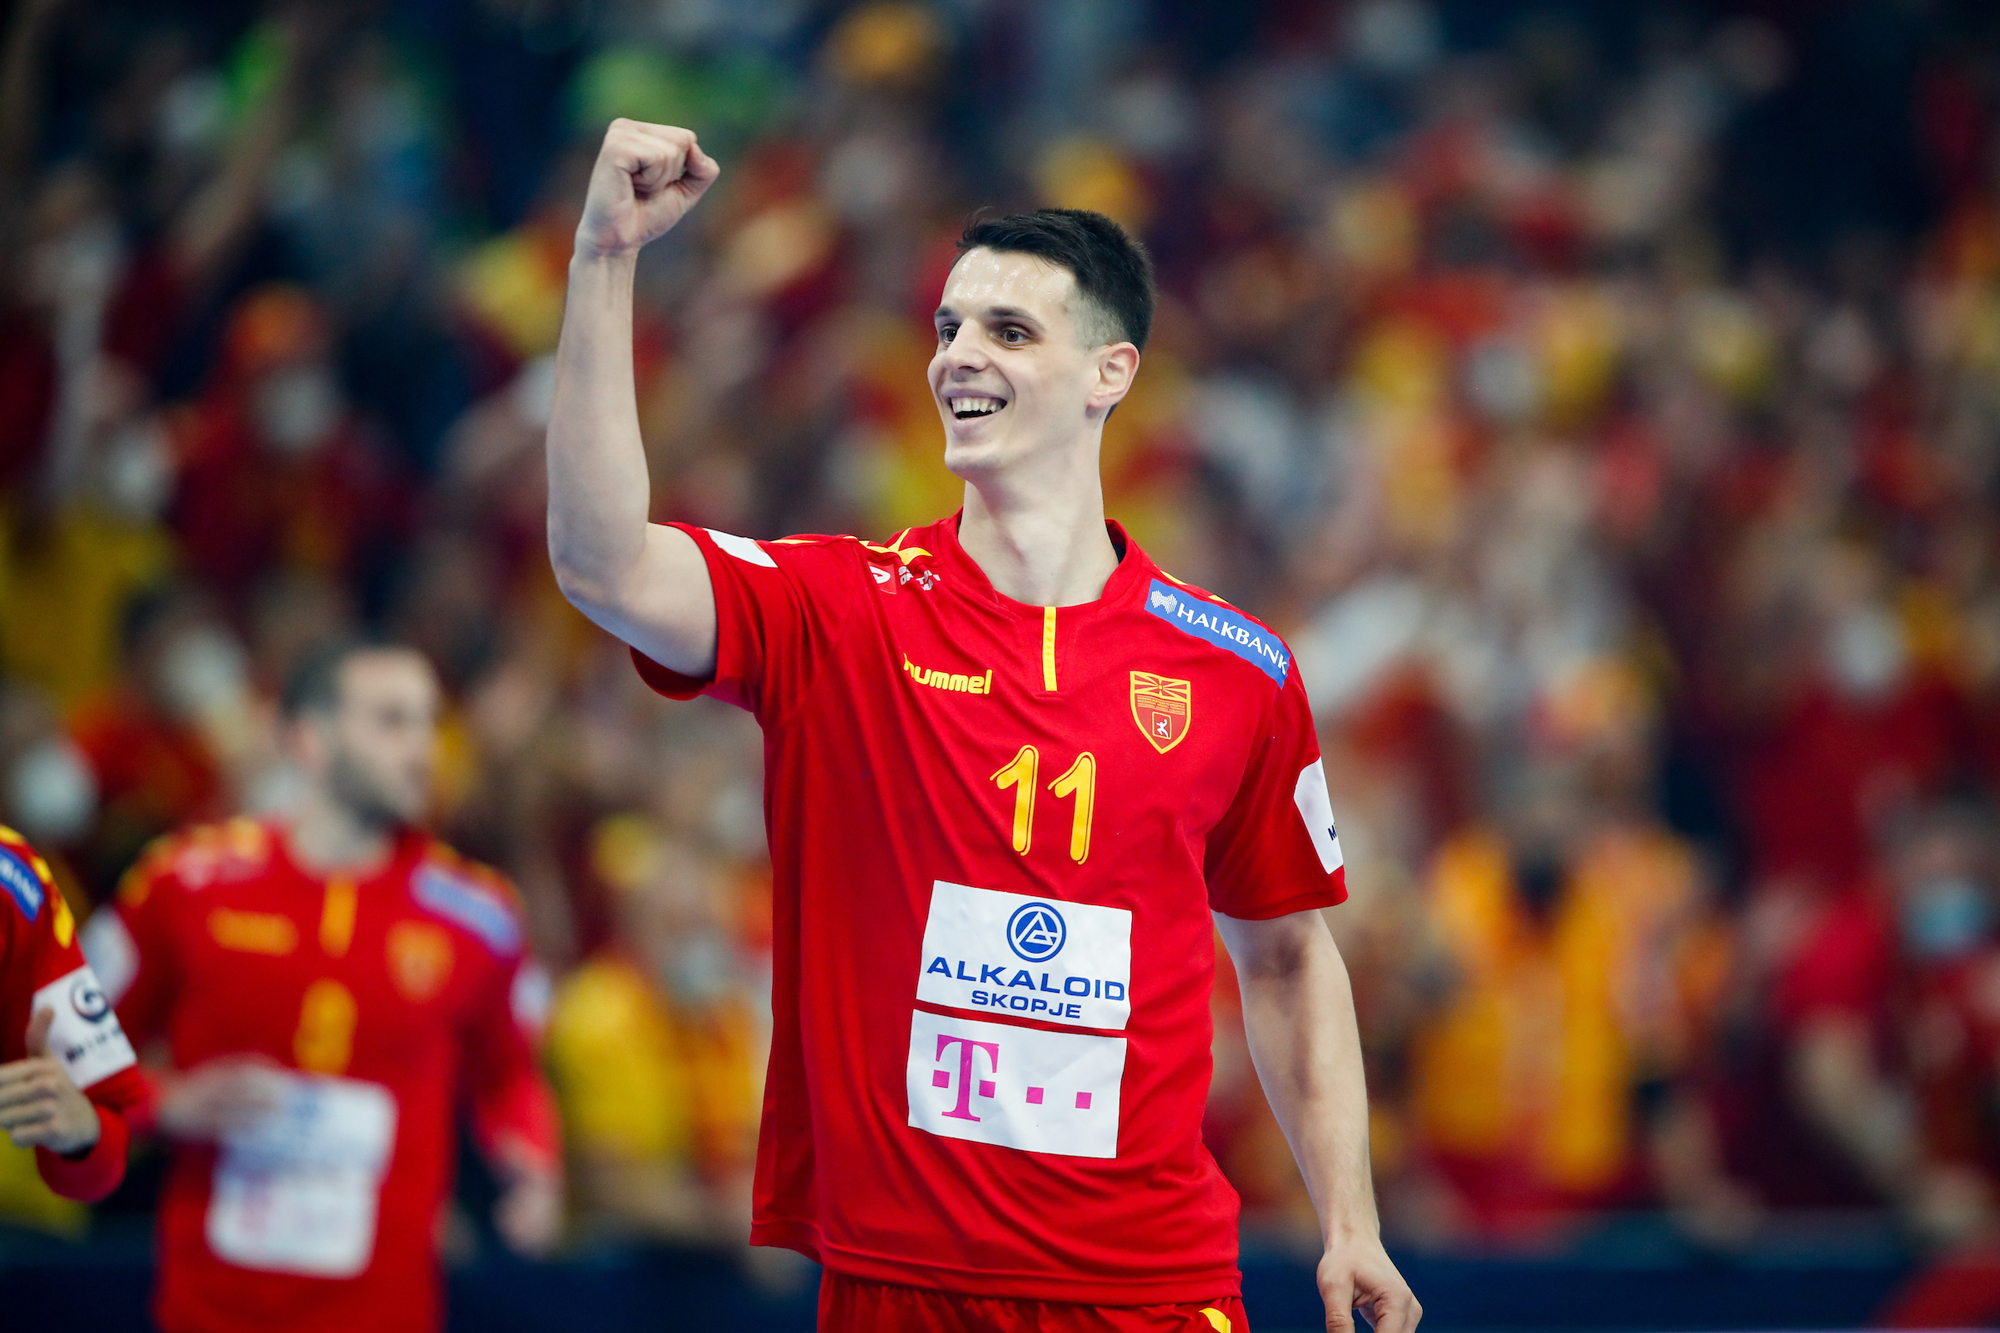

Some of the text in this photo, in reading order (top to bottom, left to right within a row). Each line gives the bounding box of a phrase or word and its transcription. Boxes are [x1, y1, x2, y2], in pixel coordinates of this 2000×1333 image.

[1177, 603, 1287, 676] HALKBANK
[903, 652, 993, 695] hummel
[990, 744, 1097, 865] 11
[926, 956, 1125, 1001] ALKALOID
[971, 989, 1082, 1019] SKOPJE
